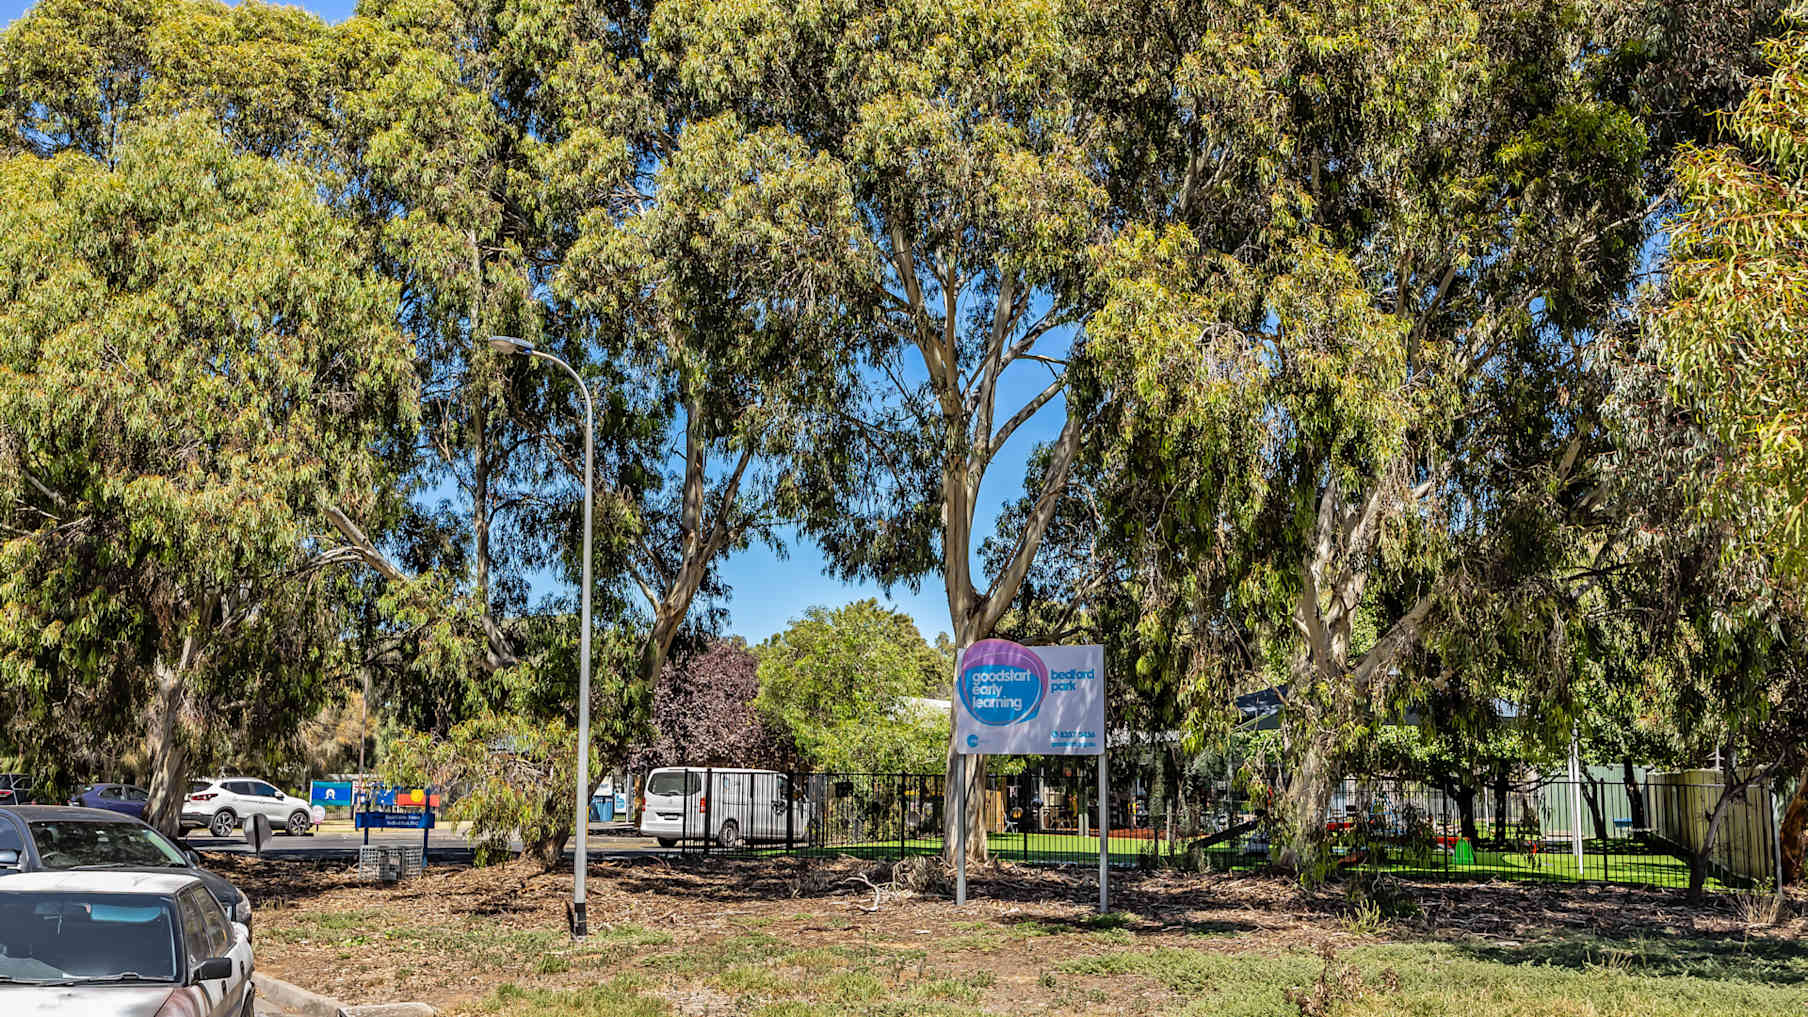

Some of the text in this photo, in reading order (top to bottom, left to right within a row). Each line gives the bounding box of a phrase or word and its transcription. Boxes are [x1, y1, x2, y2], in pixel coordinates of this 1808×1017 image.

[972, 669, 1031, 684] goodstart
[1050, 668, 1095, 680] bedford
[972, 683, 1003, 696] early
[1050, 680, 1076, 694] park
[972, 696, 1023, 711] learning
